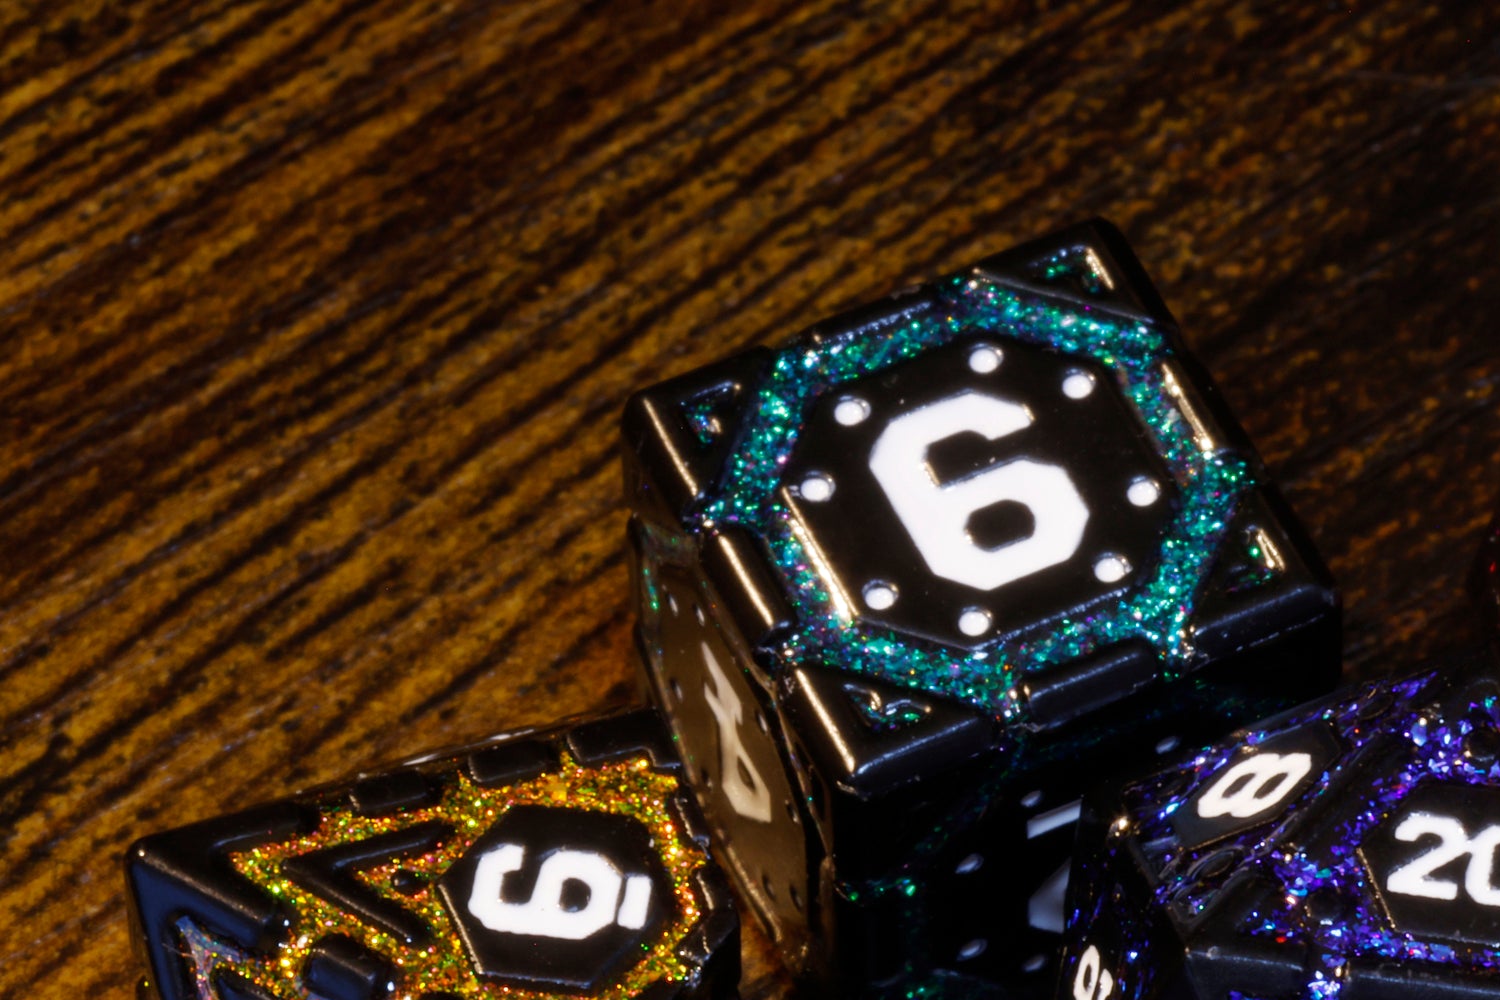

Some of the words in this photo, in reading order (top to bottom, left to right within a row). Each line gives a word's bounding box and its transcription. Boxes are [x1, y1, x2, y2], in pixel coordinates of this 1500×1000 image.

[868, 392, 1091, 591] 6
[1197, 752, 1312, 820] 8
[468, 844, 651, 939] 6
